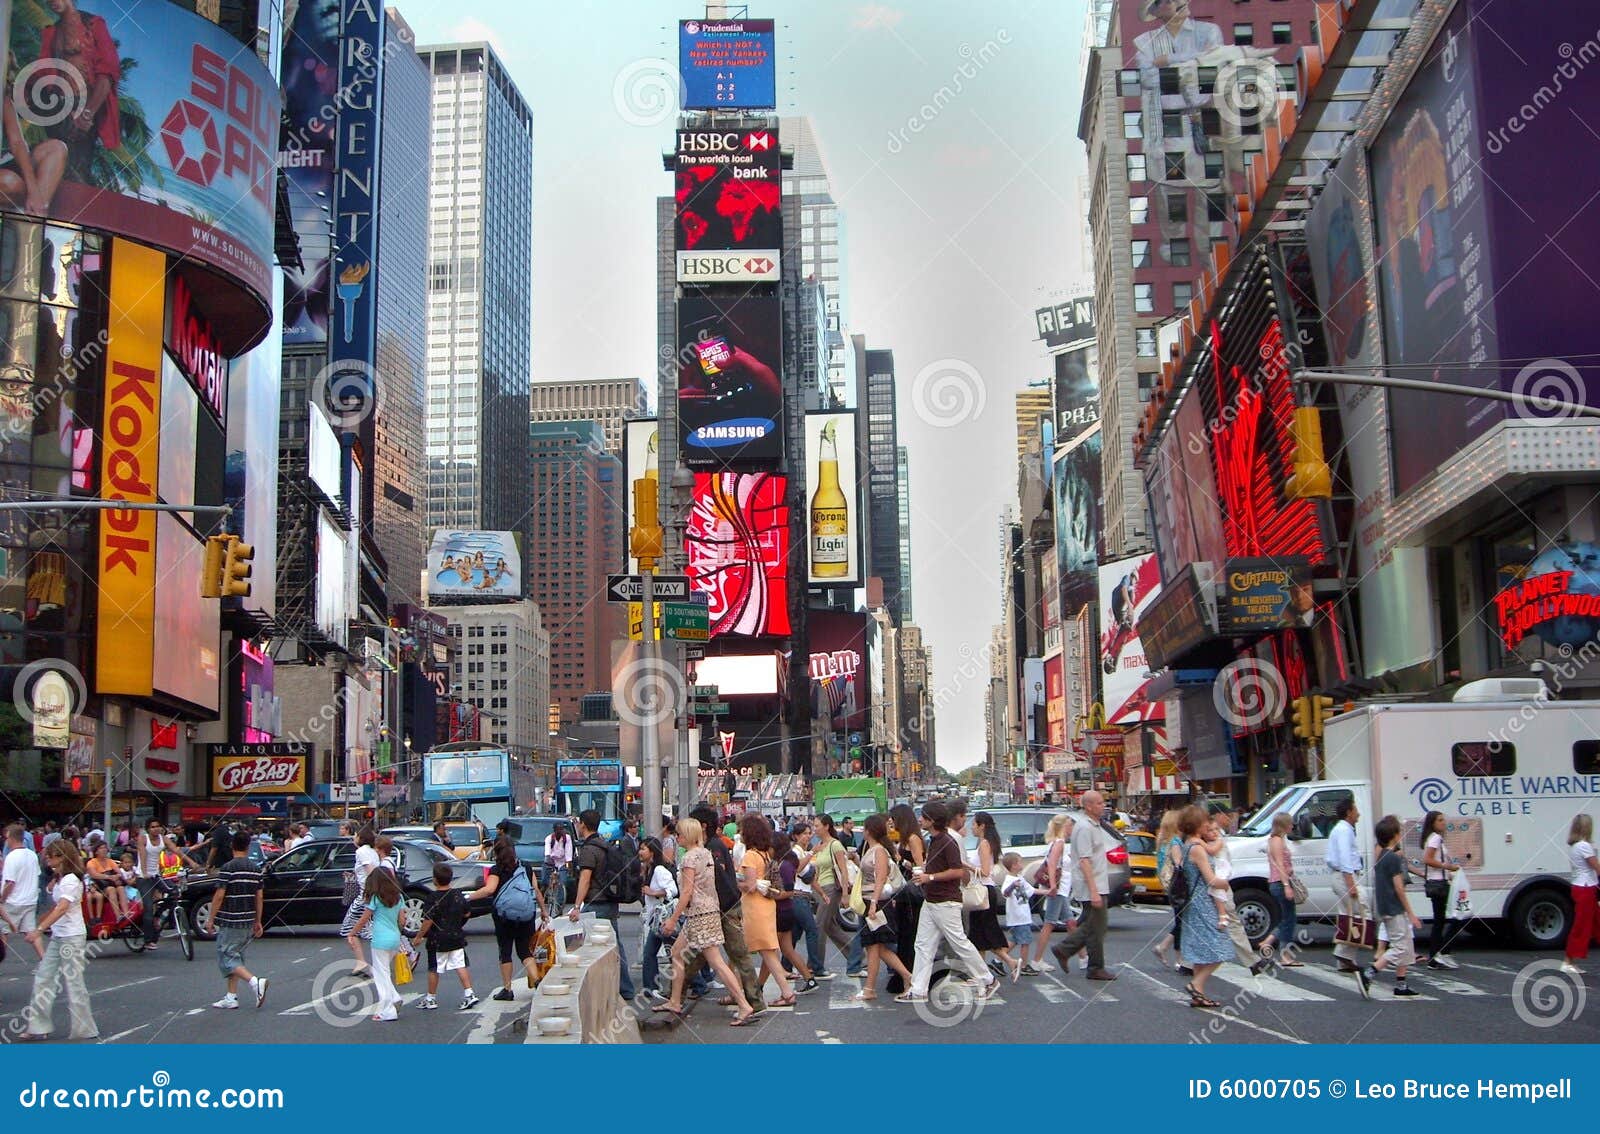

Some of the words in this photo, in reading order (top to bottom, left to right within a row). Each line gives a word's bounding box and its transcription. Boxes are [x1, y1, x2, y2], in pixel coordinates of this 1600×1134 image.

[702, 24, 743, 32] Prudential
[694, 58, 723, 66] retired
[726, 58, 764, 66] number?
[679, 133, 738, 151] HSBC
[278, 149, 325, 168] IGHT
[679, 155, 696, 163] The
[698, 154, 730, 163] world's
[732, 154, 753, 163] local
[733, 166, 768, 178] bank
[682, 258, 741, 275] HSBC
[1038, 300, 1096, 334] REN
[1061, 402, 1099, 430] PHA
[698, 426, 765, 438] SAMSUNG
[105, 361, 155, 577] Kodak
[813, 511, 846, 523] Corona
[816, 537, 843, 551] Light
[620, 583, 643, 595] ONE
[654, 583, 679, 595] WAY
[1494, 570, 1575, 628] PLANET
[685, 618, 696, 626] AVE
[1502, 593, 1600, 652] HOLLYWOO
[1123, 654, 1149, 669] maxe
[213, 744, 308, 755] MARQUIS
[219, 757, 300, 790] CRY-BABY
[697, 767, 727, 776] Pontac
[1457, 777, 1513, 795] TIME
[1520, 775, 1600, 795] WARNE
[1458, 801, 1531, 815] CABLE
